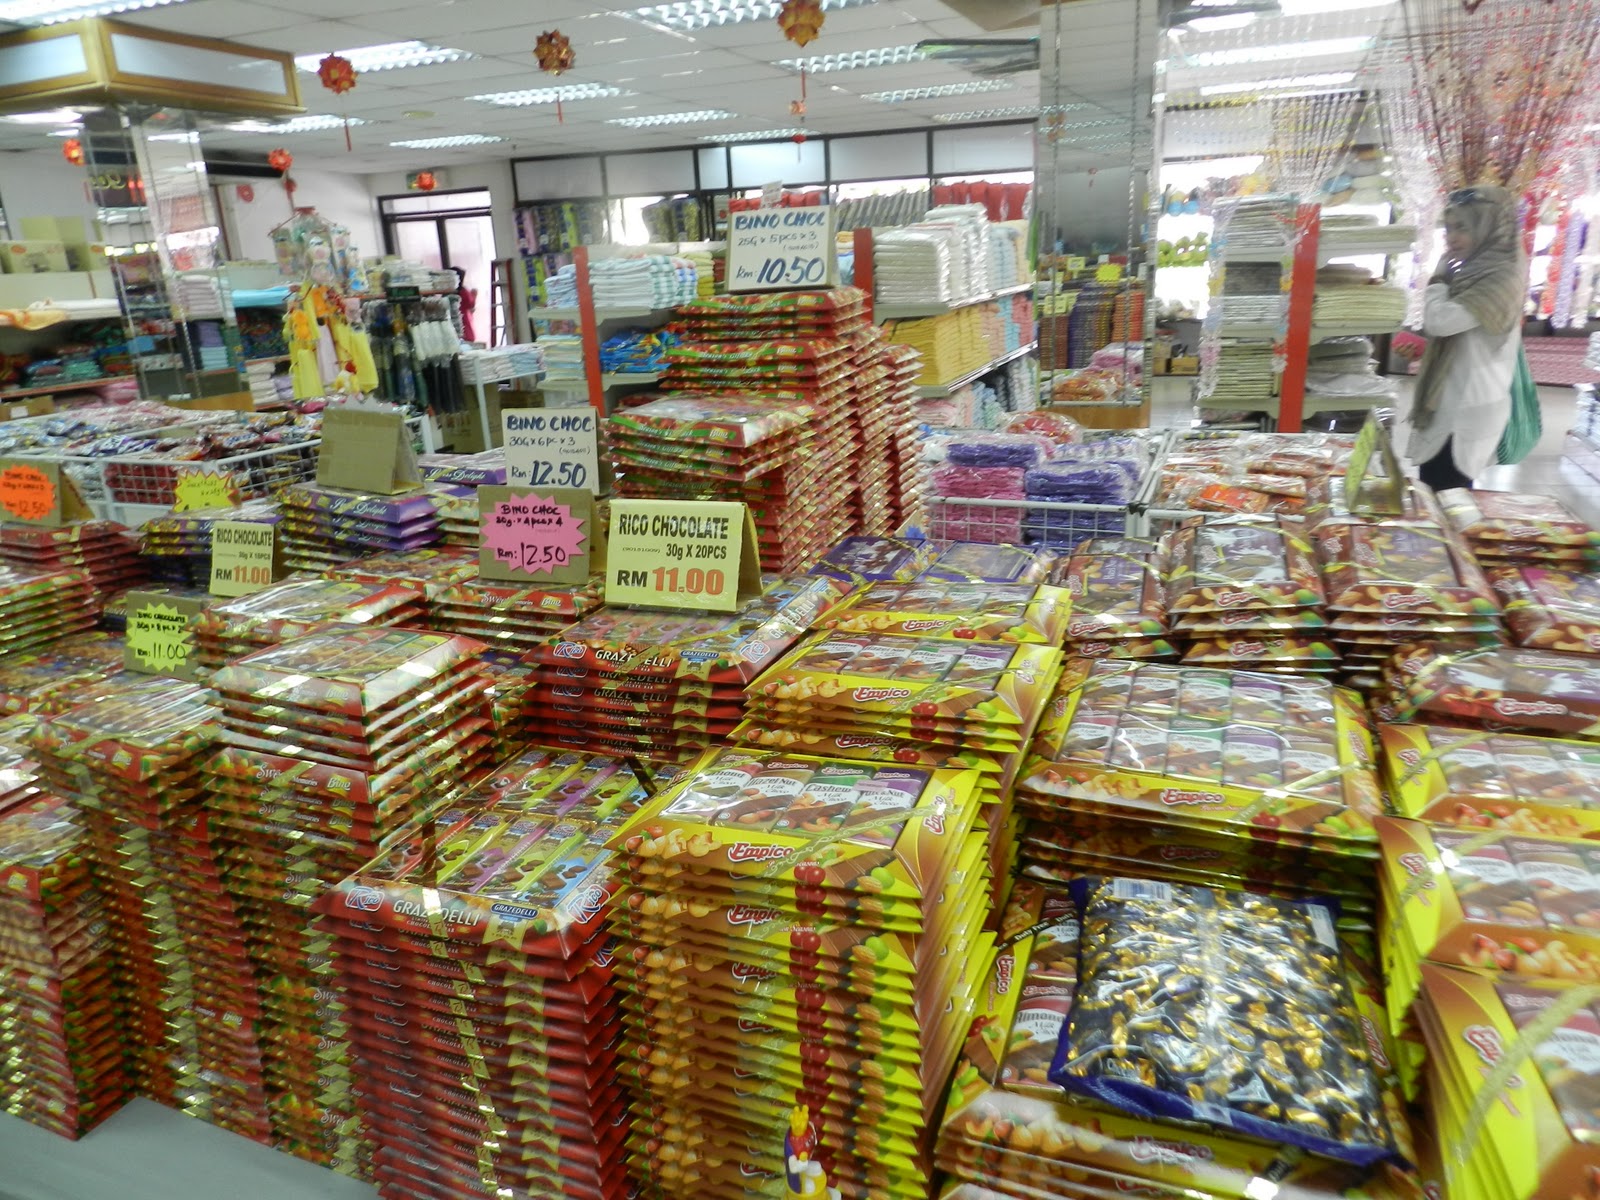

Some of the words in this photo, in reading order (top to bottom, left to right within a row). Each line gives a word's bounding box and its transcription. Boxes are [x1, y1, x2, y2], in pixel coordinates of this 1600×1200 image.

[735, 214, 781, 231] BINO
[757, 255, 825, 285] 10.50
[507, 415, 546, 432] BINO
[568, 436, 576, 446] 3
[451, 468, 486, 481] Delight
[529, 459, 587, 488] 12.50
[354, 501, 388, 516] Delight
[500, 504, 528, 516] BINO
[531, 504, 562, 517] CHOC
[619, 513, 648, 536] RICO
[651, 516, 730, 540] CHOCOLATE
[216, 528, 232, 544] RICO
[233, 529, 273, 547] CHOCOLATE
[520, 542, 567, 568] 12.50
[666, 543, 684, 561] 30g
[685, 544, 695, 558] X
[696, 545, 727, 561] 20PCS
[215, 568, 232, 581] RM
[233, 564, 271, 586] 11.00
[616, 569, 648, 588] RM
[652, 566, 725, 596] 11.00
[480, 592, 510, 605] Swee
[540, 597, 562, 608] Bing
[153, 642, 187, 660] 11.00
[553, 641, 587, 660] Rico
[326, 687, 349, 701] Bing
[853, 686, 909, 704] Empico
[836, 733, 892, 748] Empico
[326, 778, 351, 792] Bing
[805, 784, 852, 794] Cashew
[1159, 788, 1225, 806] Empico
[329, 815, 353, 828] Bing
[728, 842, 795, 862] Empico
[345, 886, 385, 912] Rico
[567, 884, 611, 924] Rico
[393, 899, 480, 927] GRAZDELLI
[493, 903, 537, 918] GRAZEDELLI
[1014, 928, 1032, 942] Duty
[1031, 920, 1050, 933] Free
[995, 954, 1016, 995] Empico
[1023, 985, 1068, 997] Empico
